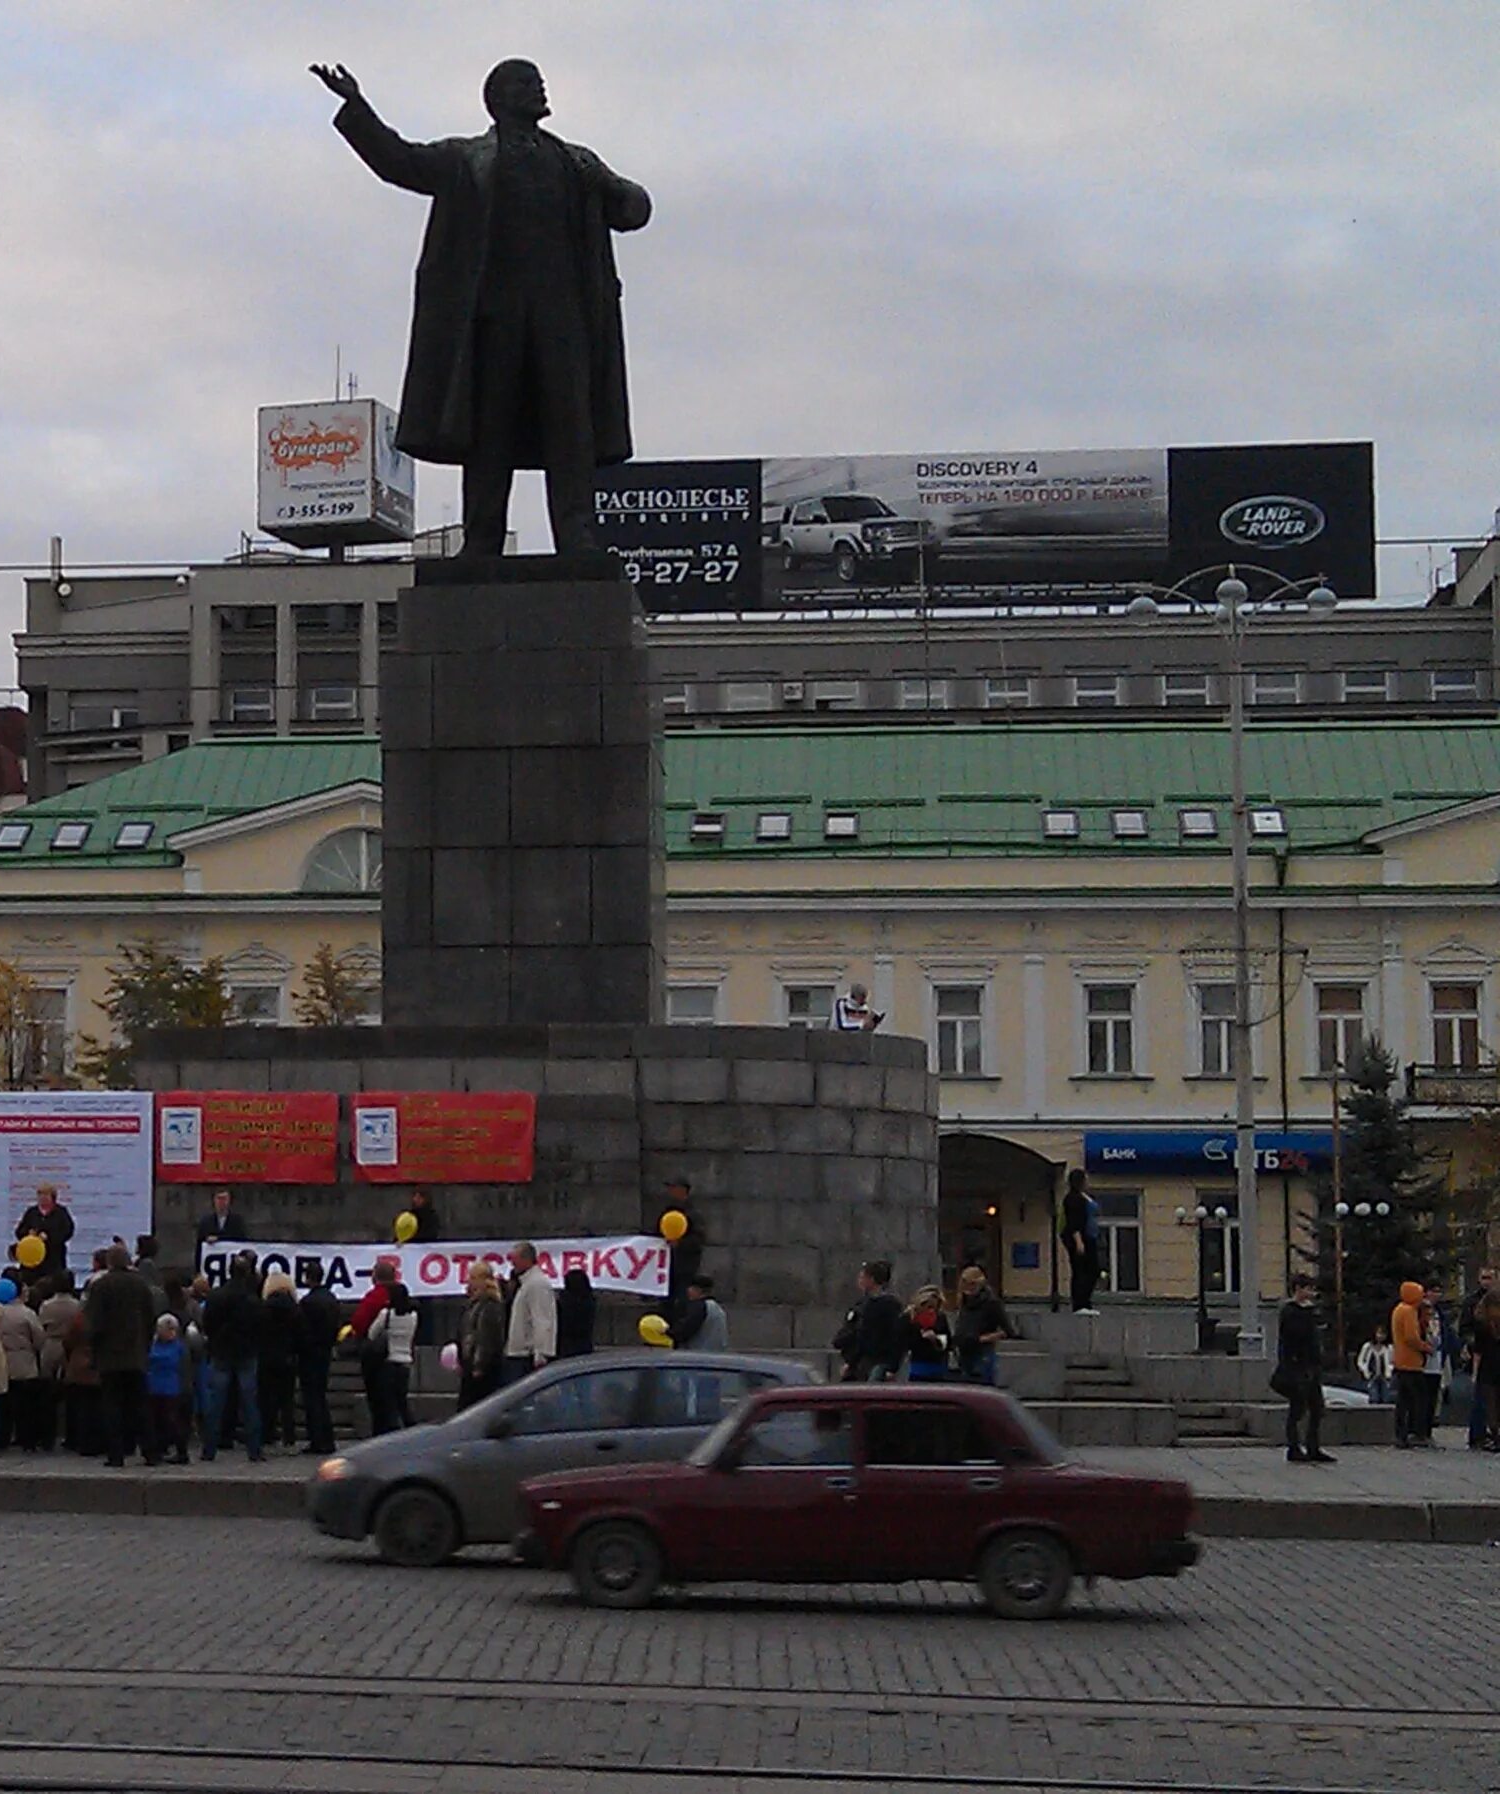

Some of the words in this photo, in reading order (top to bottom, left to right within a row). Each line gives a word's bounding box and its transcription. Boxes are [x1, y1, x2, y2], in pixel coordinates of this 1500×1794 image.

[916, 461, 1020, 478] DISCOVERY
[1025, 460, 1038, 475] 4
[595, 488, 749, 509] РАСНОЛЕСЬЕ
[919, 490, 972, 504] ТЕПЕРЬ
[977, 490, 998, 503] НА
[287, 502, 355, 518] 3-555-199
[701, 544, 722, 557] 57
[727, 544, 739, 556] А
[624, 560, 739, 584] 9-27-27
[1103, 1147, 1137, 1160] БАНК
[1233, 1149, 1309, 1171] ТБ24
[419, 1245, 667, 1285] ОТСАВКУ!
